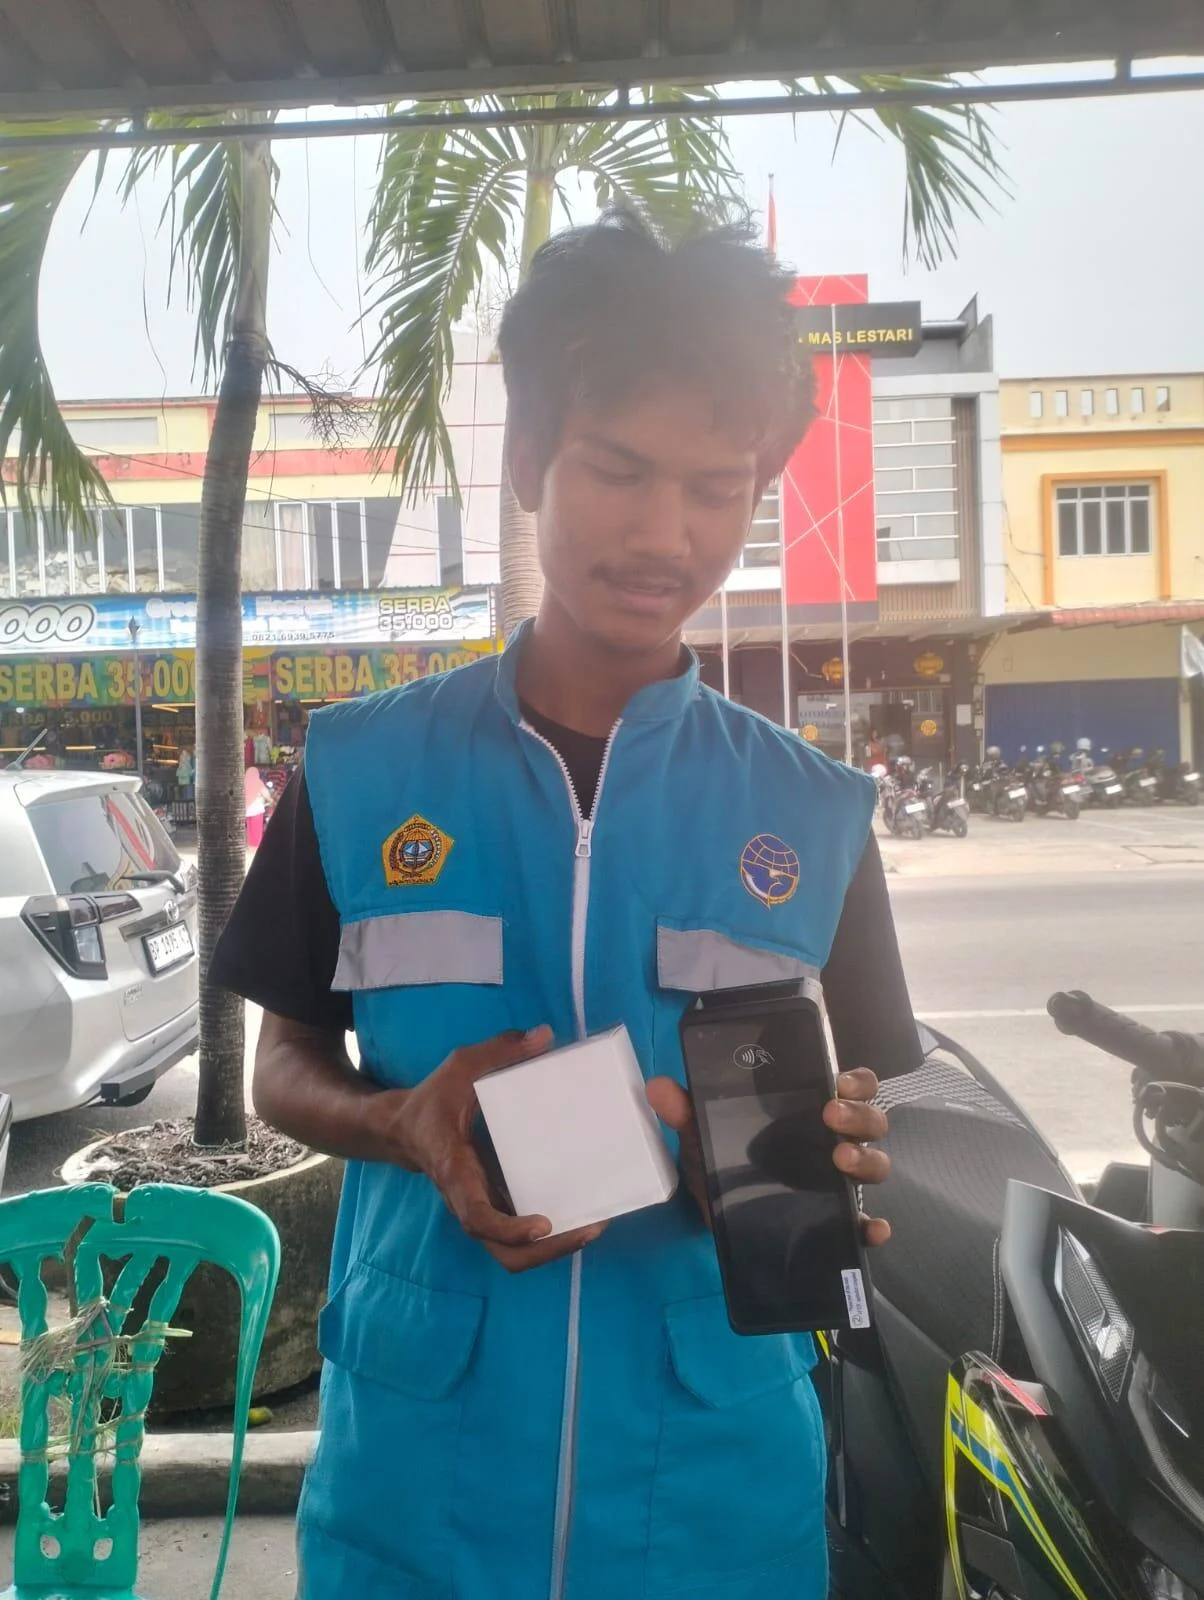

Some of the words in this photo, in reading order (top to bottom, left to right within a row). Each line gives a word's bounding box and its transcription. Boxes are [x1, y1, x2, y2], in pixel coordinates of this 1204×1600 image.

[847, 328, 912, 343] LESTARI
[380, 597, 451, 614] SERBA
[0, 661, 98, 702] SERBA
[275, 655, 375, 695] SERBA
